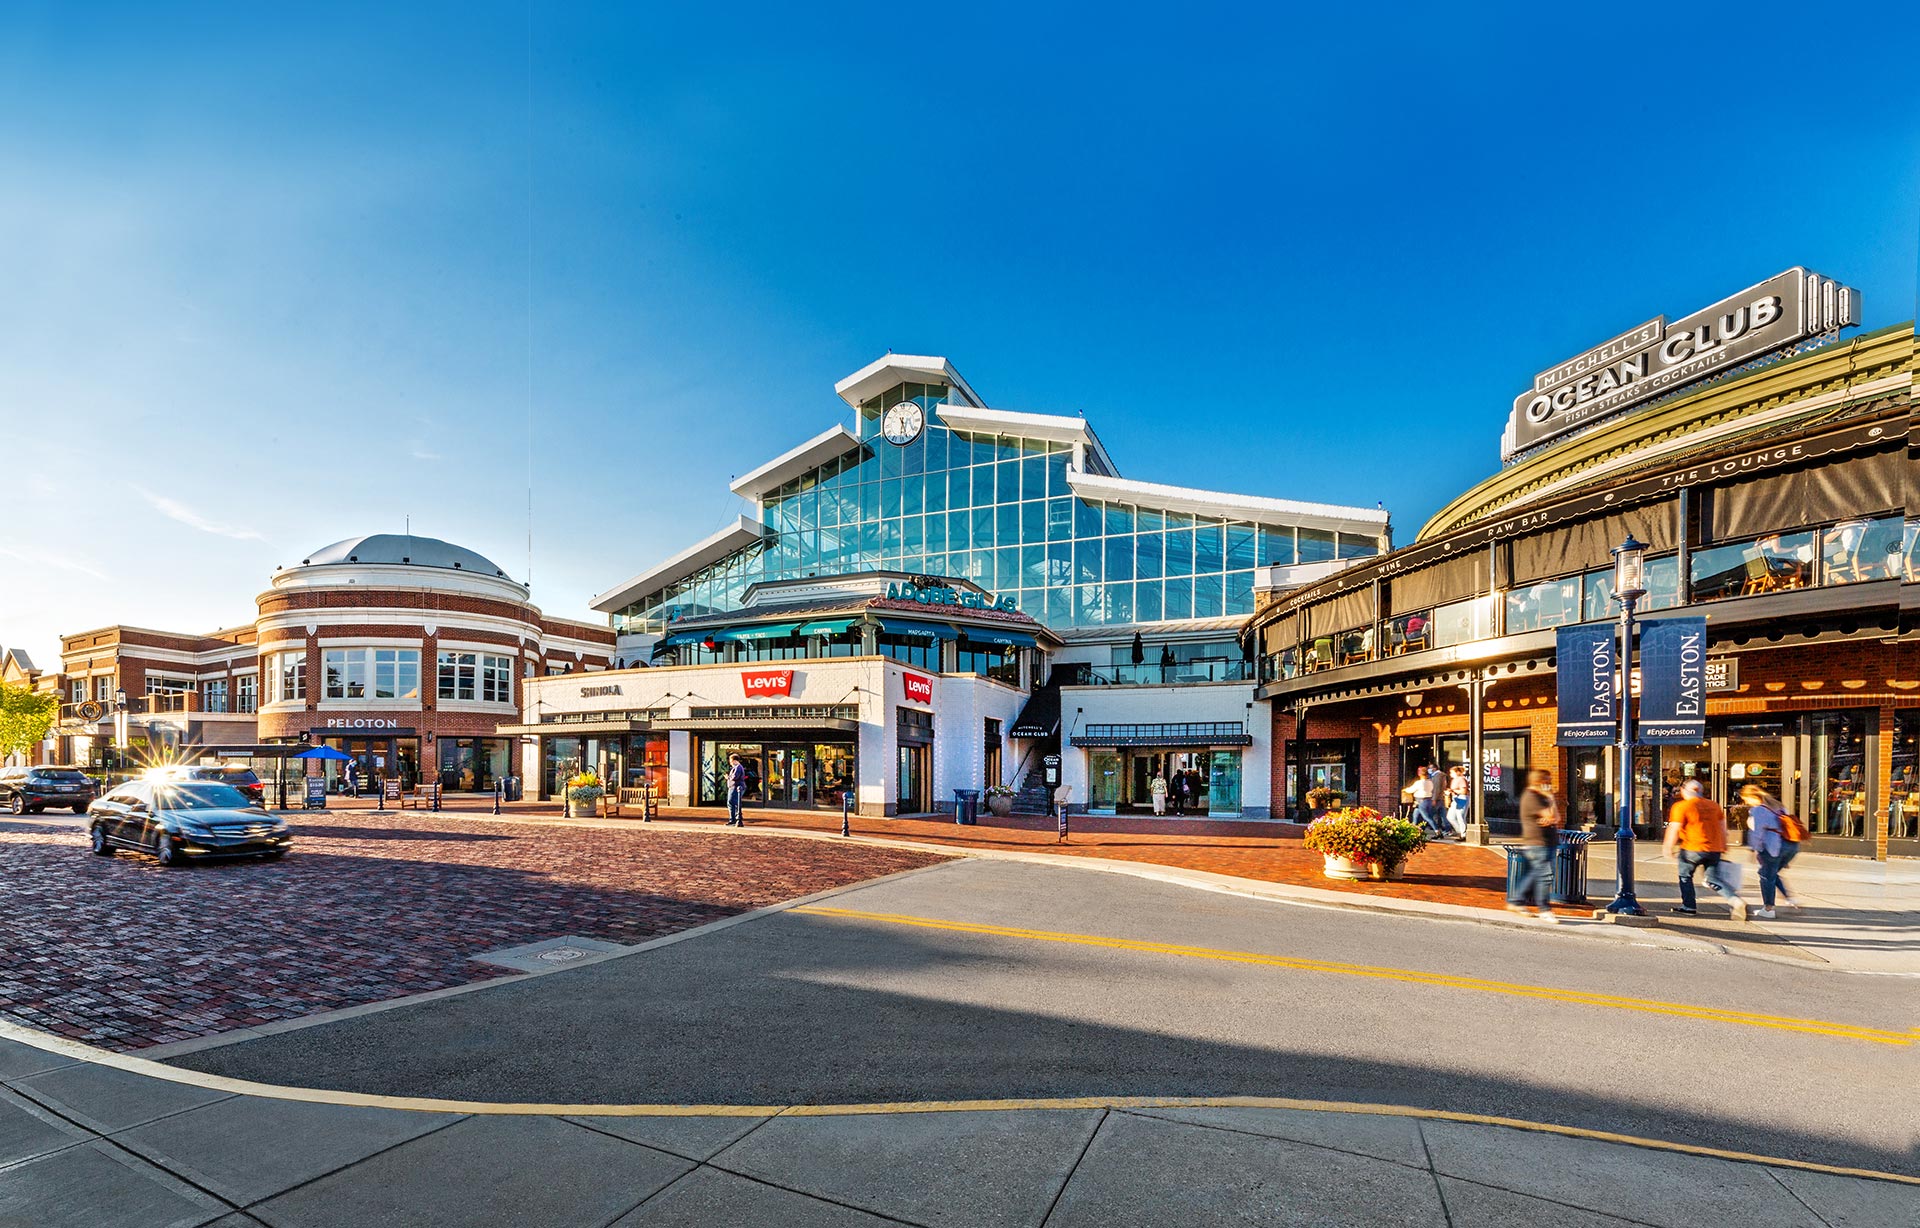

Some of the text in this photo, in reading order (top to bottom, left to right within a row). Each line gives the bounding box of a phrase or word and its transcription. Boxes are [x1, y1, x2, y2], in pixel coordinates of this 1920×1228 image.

[1526, 295, 1780, 423] OCEAN CLUB
[1544, 330, 1649, 387] MITCHELL'S
[1565, 351, 1726, 424] FISH STEAKS COCKTAILS
[1662, 445, 1802, 486] THE LOUNGE
[1488, 513, 1548, 537] RAW BAR
[1378, 561, 1401, 574] WINE
[886, 582, 957, 605] ADOBE
[1290, 589, 1321, 606] COCKTAILS
[580, 685, 622, 698] SHINOLA
[327, 719, 397, 728] PELOTON
[1647, 728, 1695, 736] #EnjoyEaston
[1564, 729, 1609, 737] #EnjoyEaston
[1462, 748, 1501, 763] LSH
